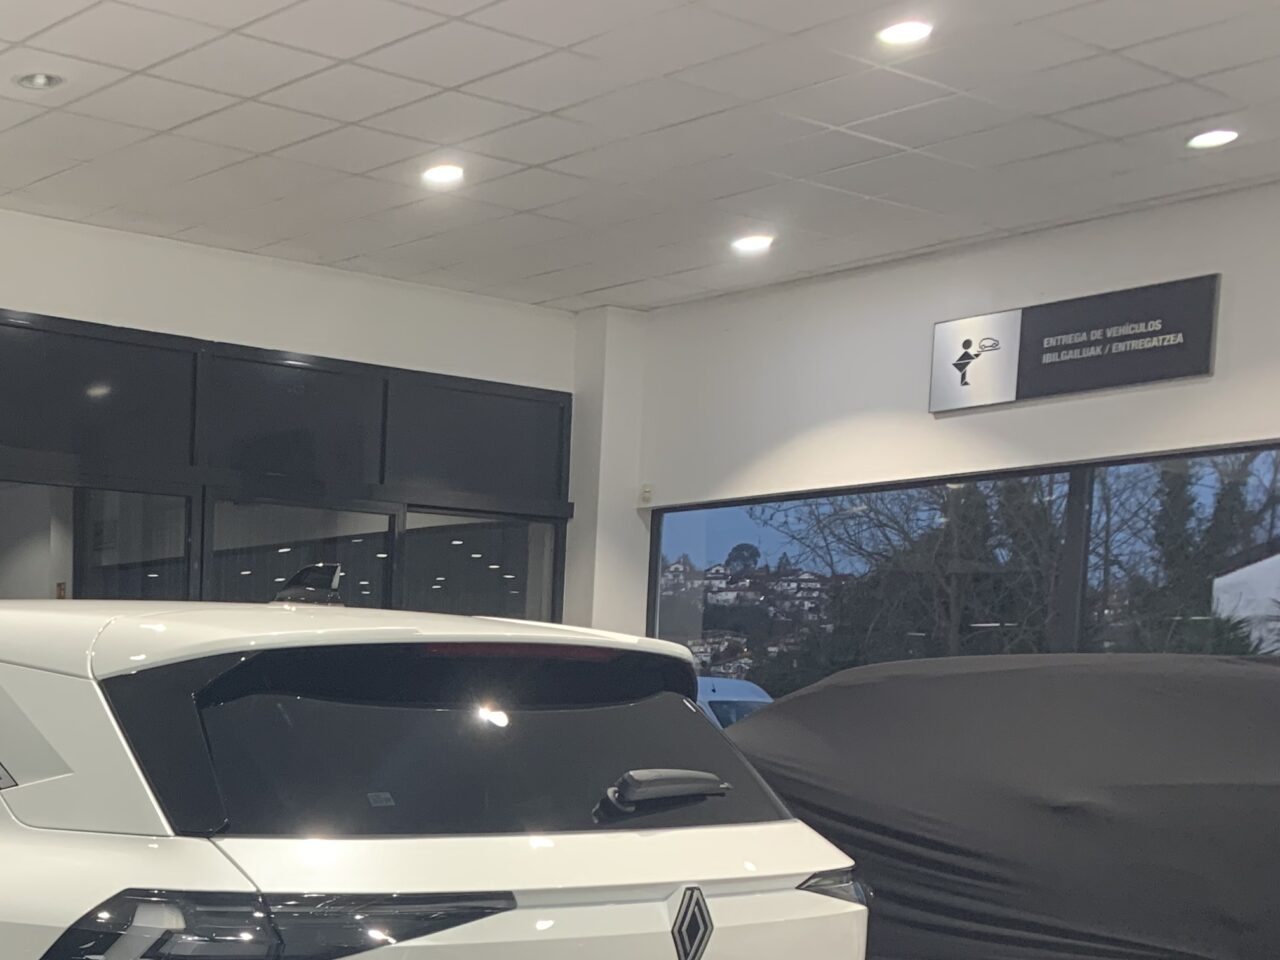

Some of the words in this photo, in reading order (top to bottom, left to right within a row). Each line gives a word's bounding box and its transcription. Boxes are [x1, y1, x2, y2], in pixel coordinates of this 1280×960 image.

[1042, 345, 1103, 364] IBILGAILUAK
[1112, 333, 1184, 354] ENTREGATZEA
[1043, 331, 1087, 348] ENTREGA
[1090, 328, 1104, 341] DE
[1106, 319, 1162, 339] VEHÍCULOS
